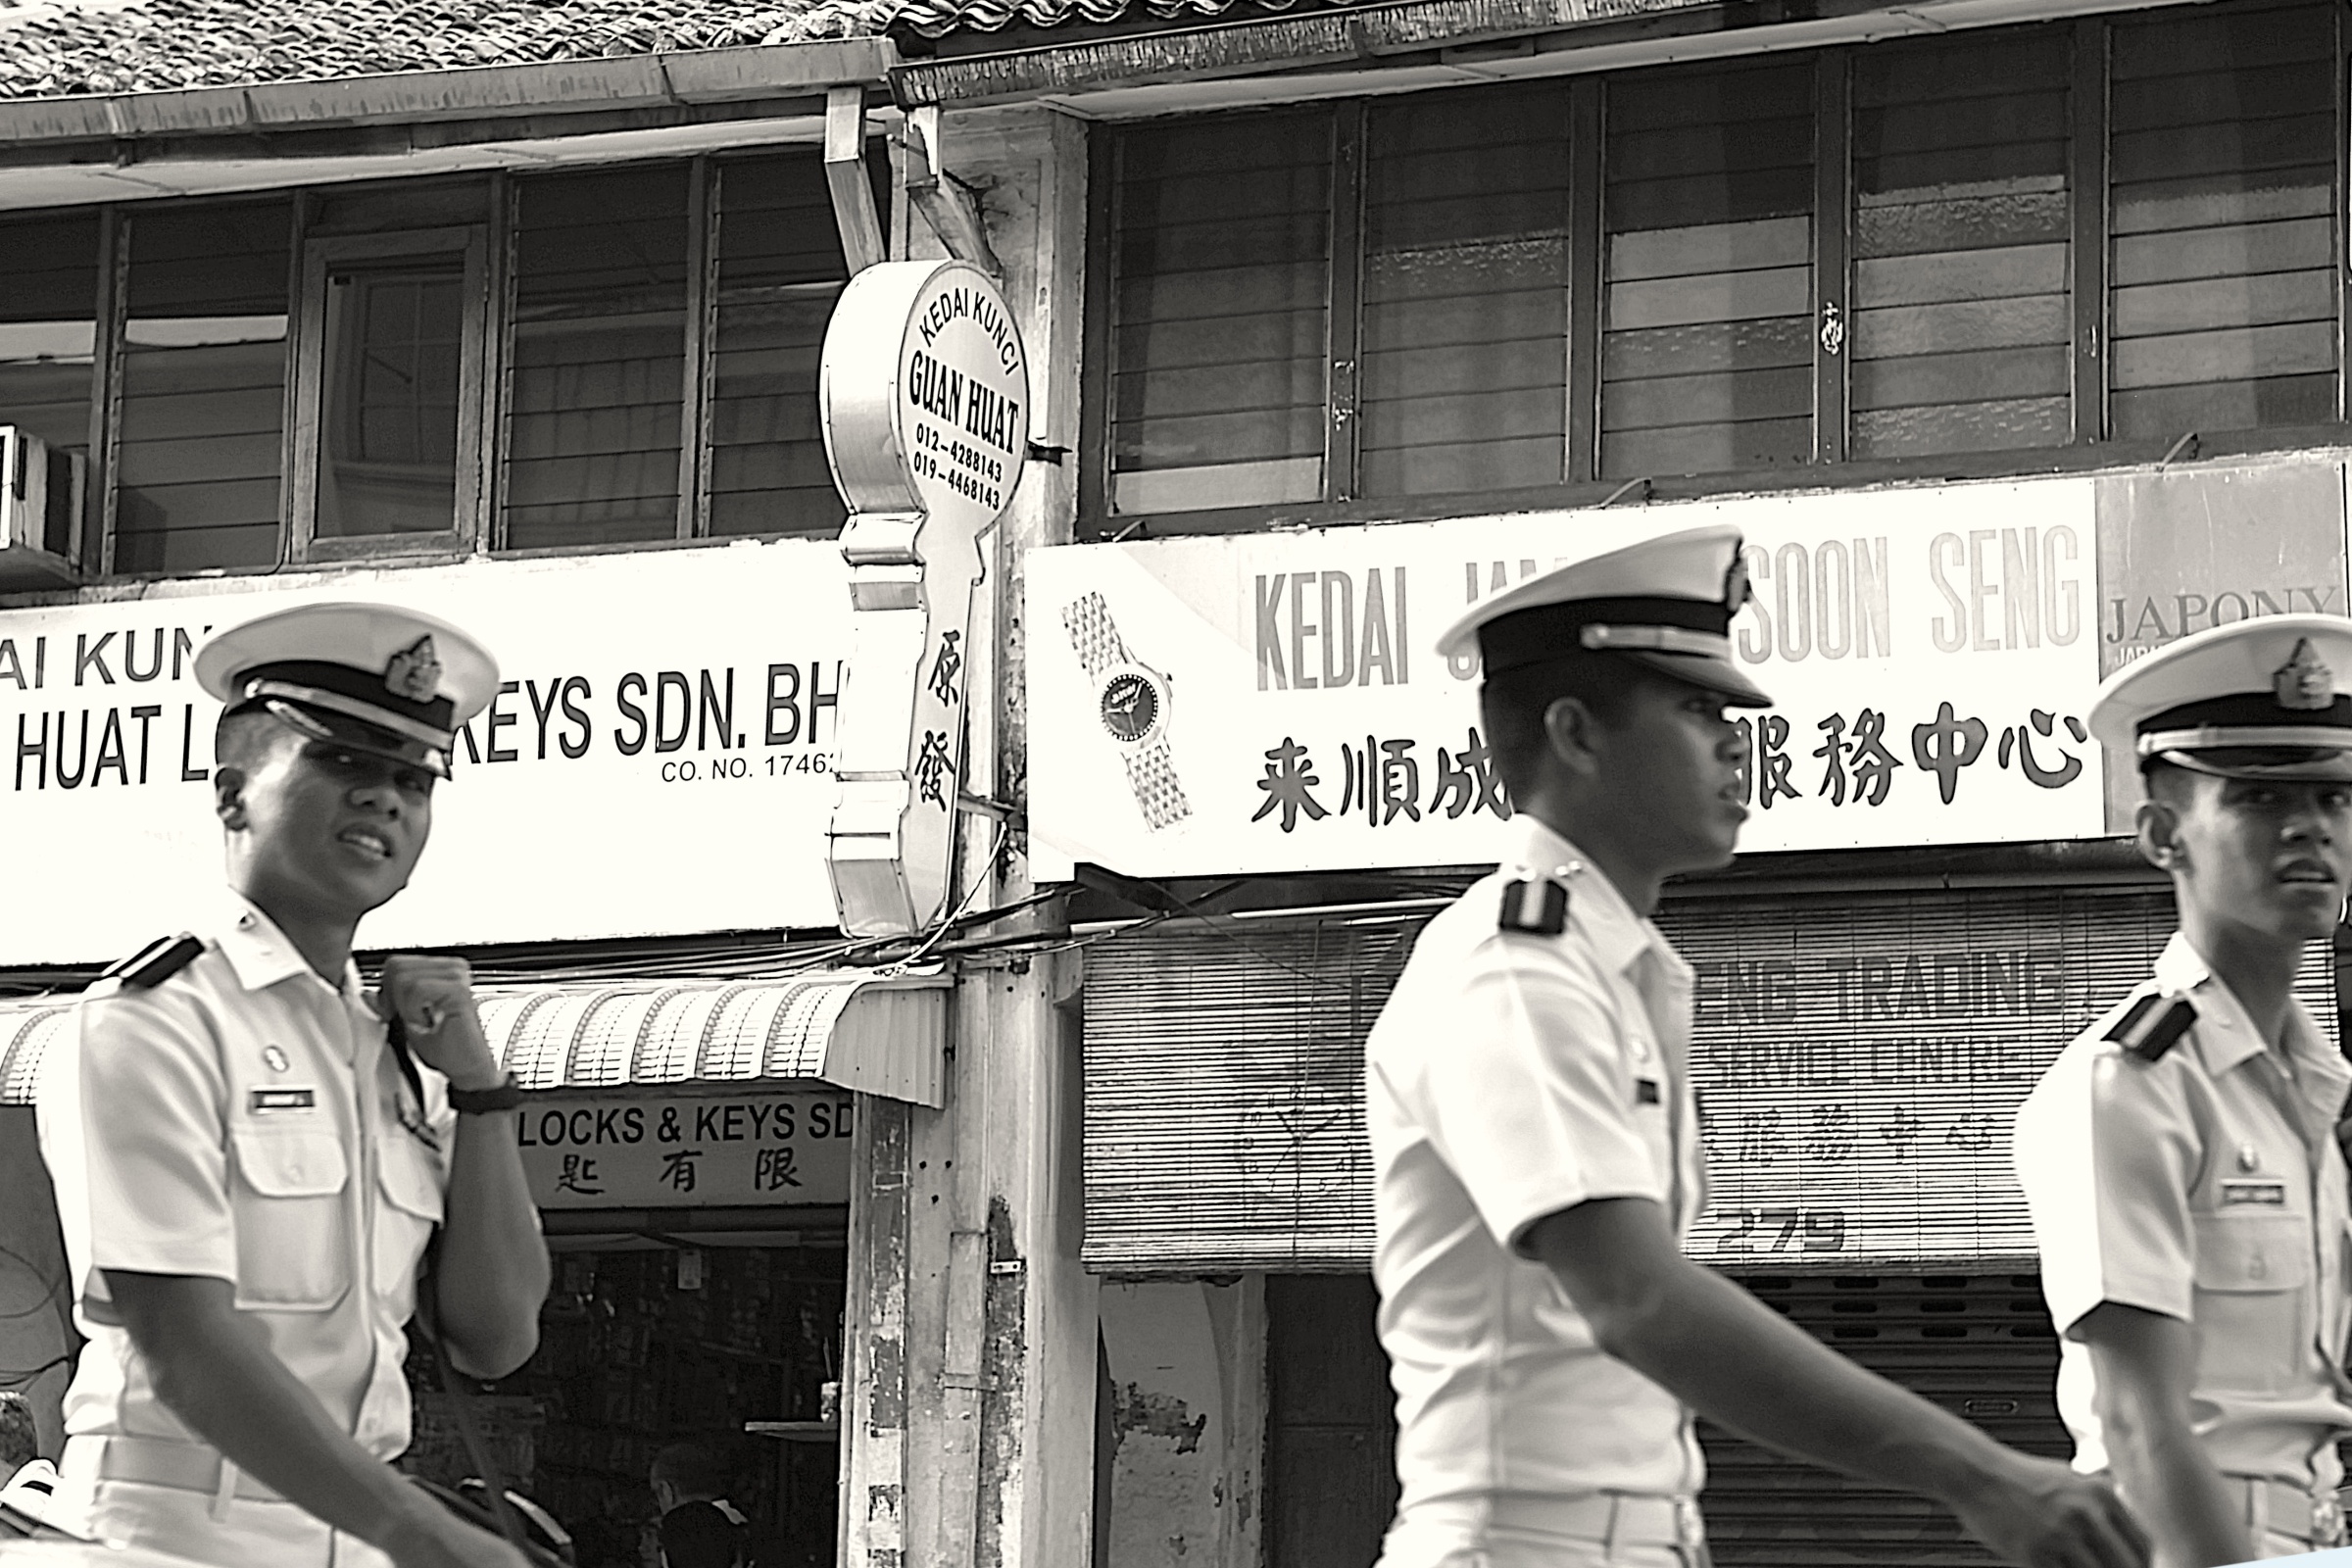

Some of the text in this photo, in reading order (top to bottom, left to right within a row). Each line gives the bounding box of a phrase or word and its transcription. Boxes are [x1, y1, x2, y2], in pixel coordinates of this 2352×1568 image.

[919, 287, 1019, 375] KEDAI KUNCI
[909, 350, 1019, 455] GUAN HUAT
[913, 451, 1000, 512] 019-4468143
[916, 422, 1003, 483] 012-4288143
[1255, 565, 1409, 692] KEDAI
[1739, 536, 1891, 664] SOON
[1930, 524, 2081, 654] SENG
[15, 704, 162, 791] HUAT
[613, 665, 746, 757] SDN.
[661, 752, 833, 783] CO. NO. 1746
[1826, 952, 2061, 1022] TRADING
[1707, 1035, 2023, 1088] SERVICE CENTRE
[517, 1107, 645, 1147] LOCKS
[657, 1105, 682, 1143] &
[695, 1102, 796, 1143] KEYS
[1716, 1207, 1845, 1252] 279
